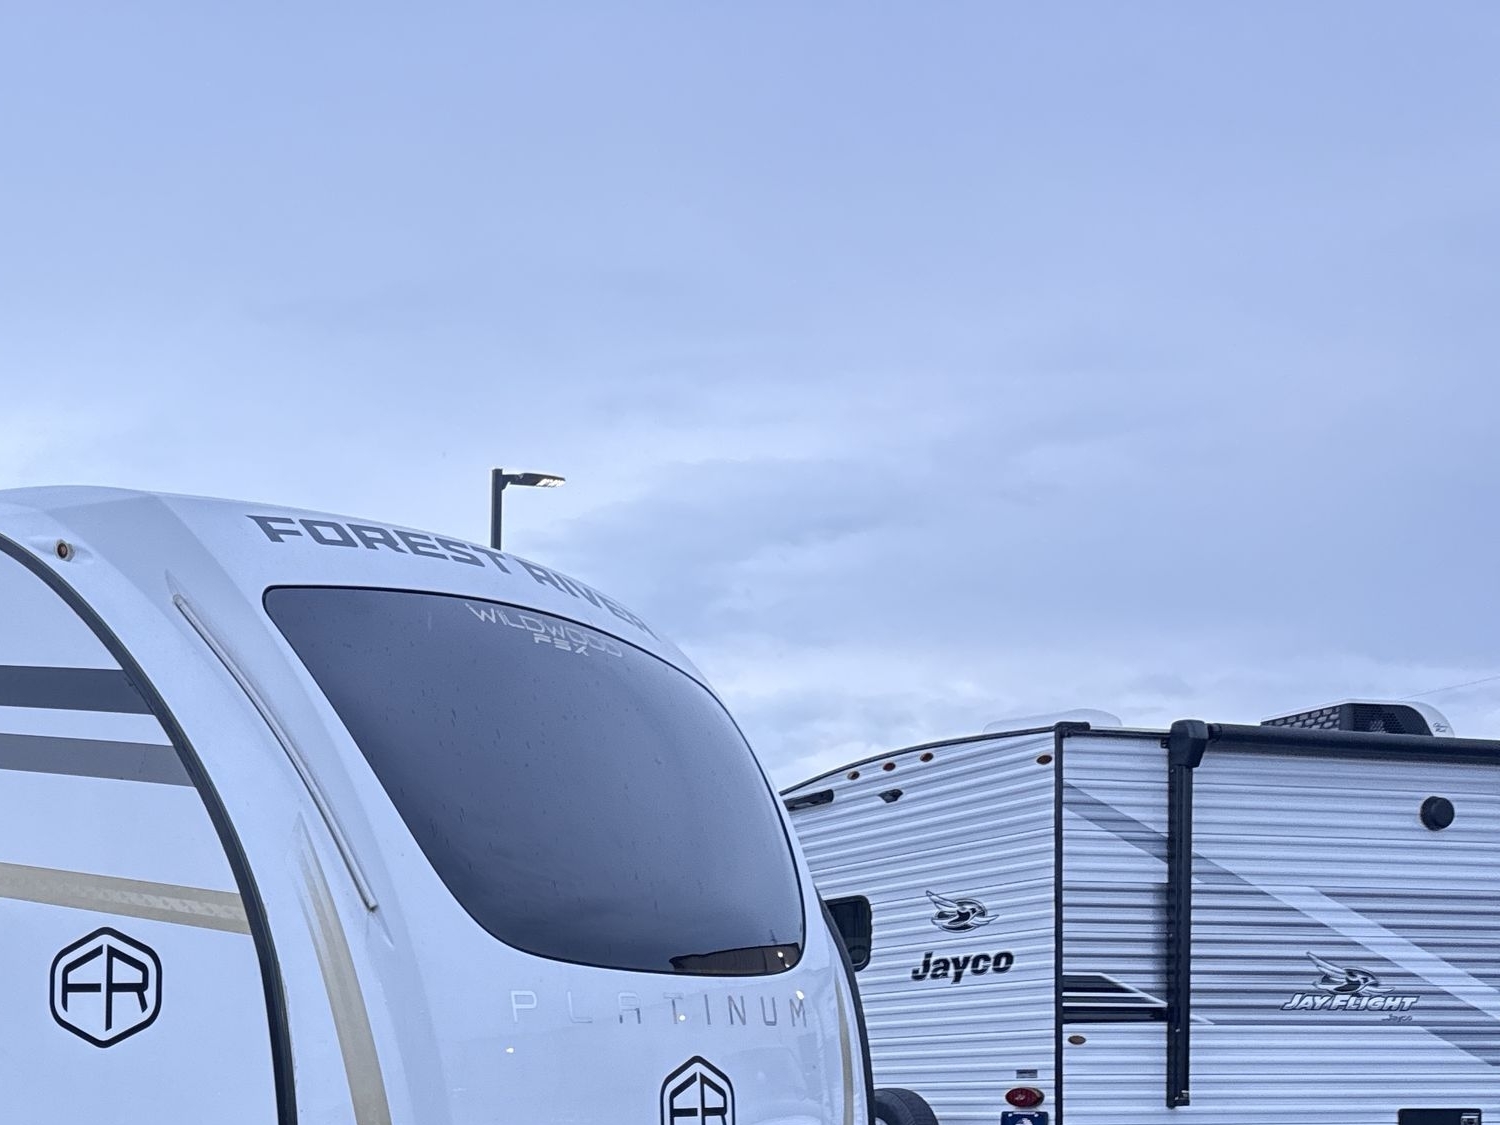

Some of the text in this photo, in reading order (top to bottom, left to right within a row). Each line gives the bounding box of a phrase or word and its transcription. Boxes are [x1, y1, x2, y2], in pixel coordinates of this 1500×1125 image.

[246, 515, 660, 642] FOREST RIVER
[465, 603, 623, 657] WILDWOOD
[911, 951, 1014, 985] Jayco
[510, 988, 808, 1028] PLATINUM
[1281, 992, 1420, 1011] JAY FLIGHT
